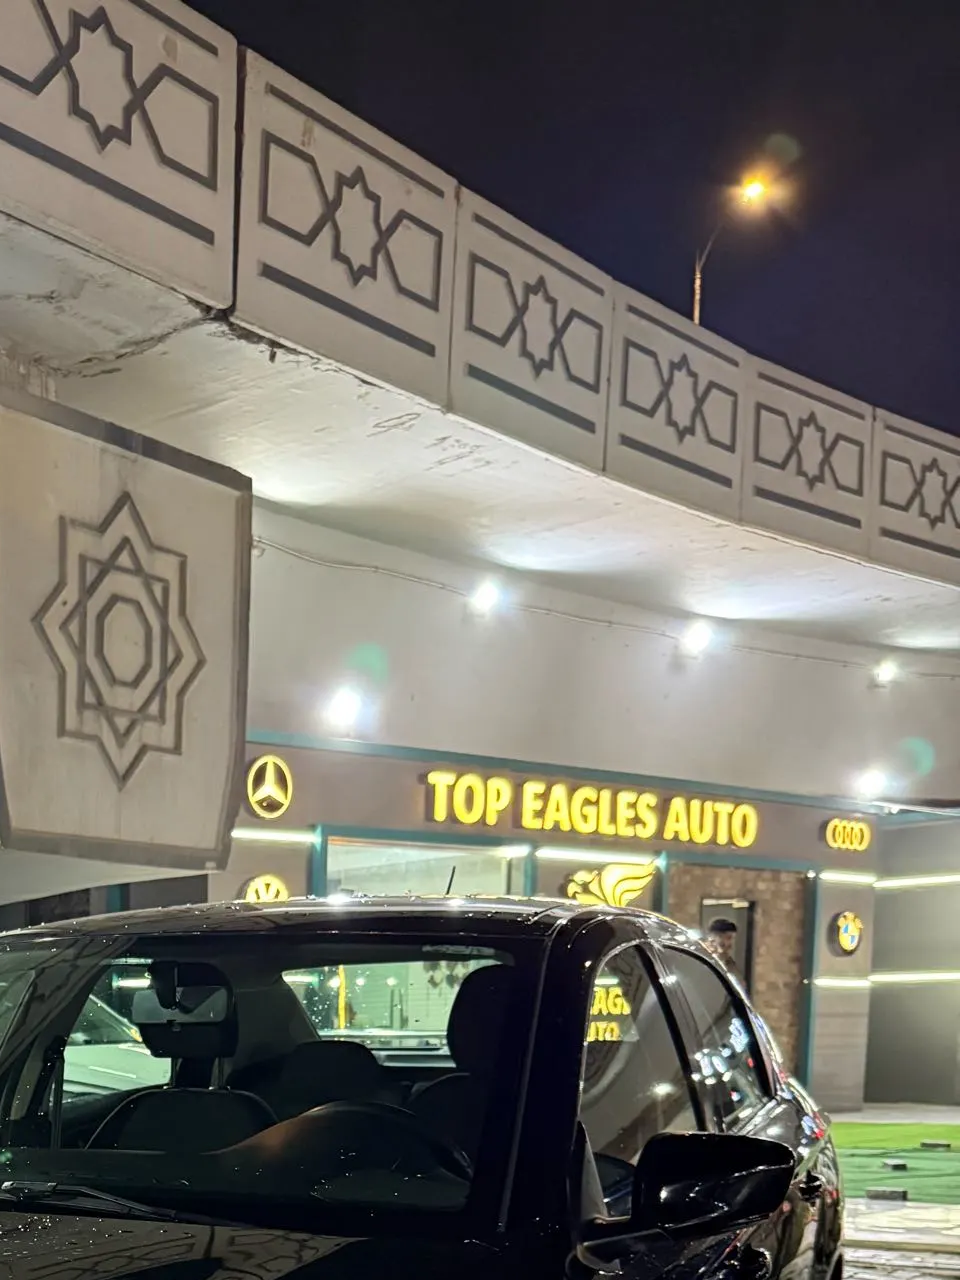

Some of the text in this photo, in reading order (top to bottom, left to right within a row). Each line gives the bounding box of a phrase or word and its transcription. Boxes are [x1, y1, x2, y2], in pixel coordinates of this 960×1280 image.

[427, 770, 758, 848] TOP EAGLES AUTO
